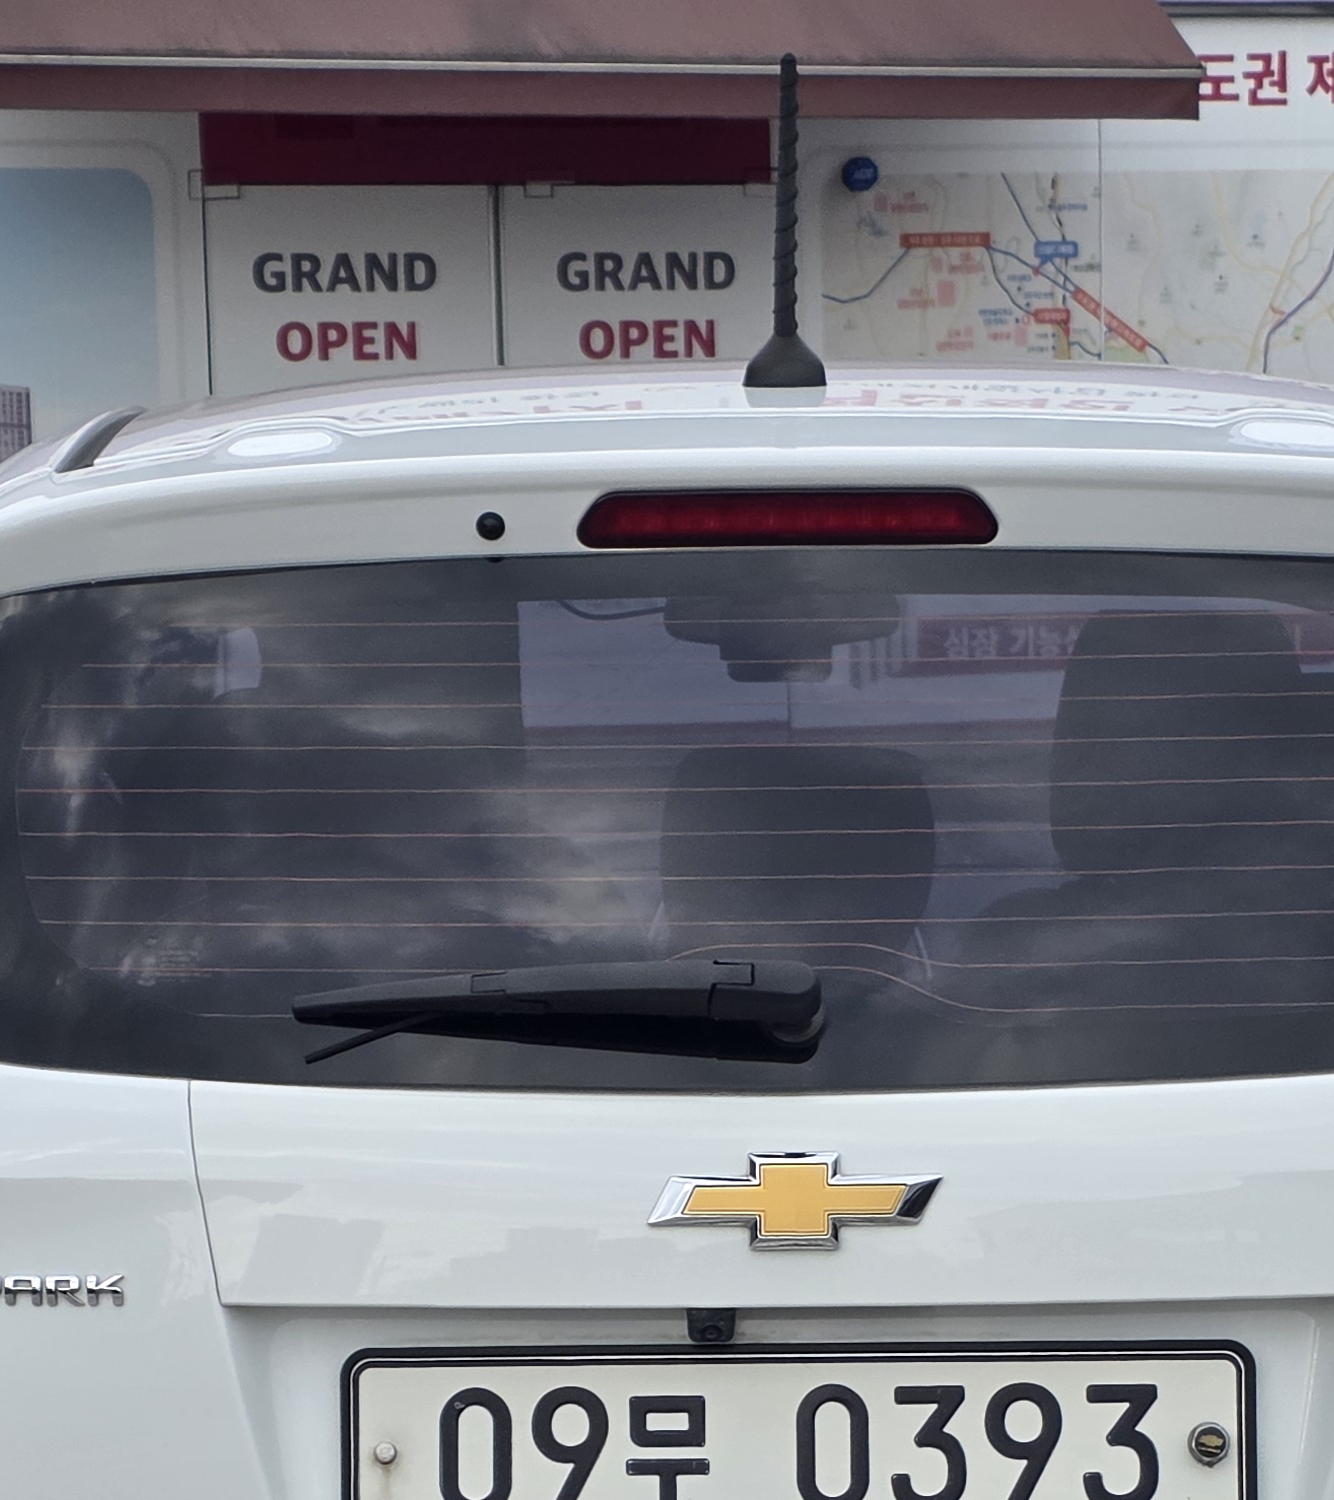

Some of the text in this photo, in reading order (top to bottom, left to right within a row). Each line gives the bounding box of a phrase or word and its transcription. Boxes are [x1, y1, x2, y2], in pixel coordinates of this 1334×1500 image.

[252, 251, 437, 294] GRAND
[556, 250, 736, 292] GRAND
[276, 321, 418, 362] OPEN
[578, 319, 716, 360] OPEN
